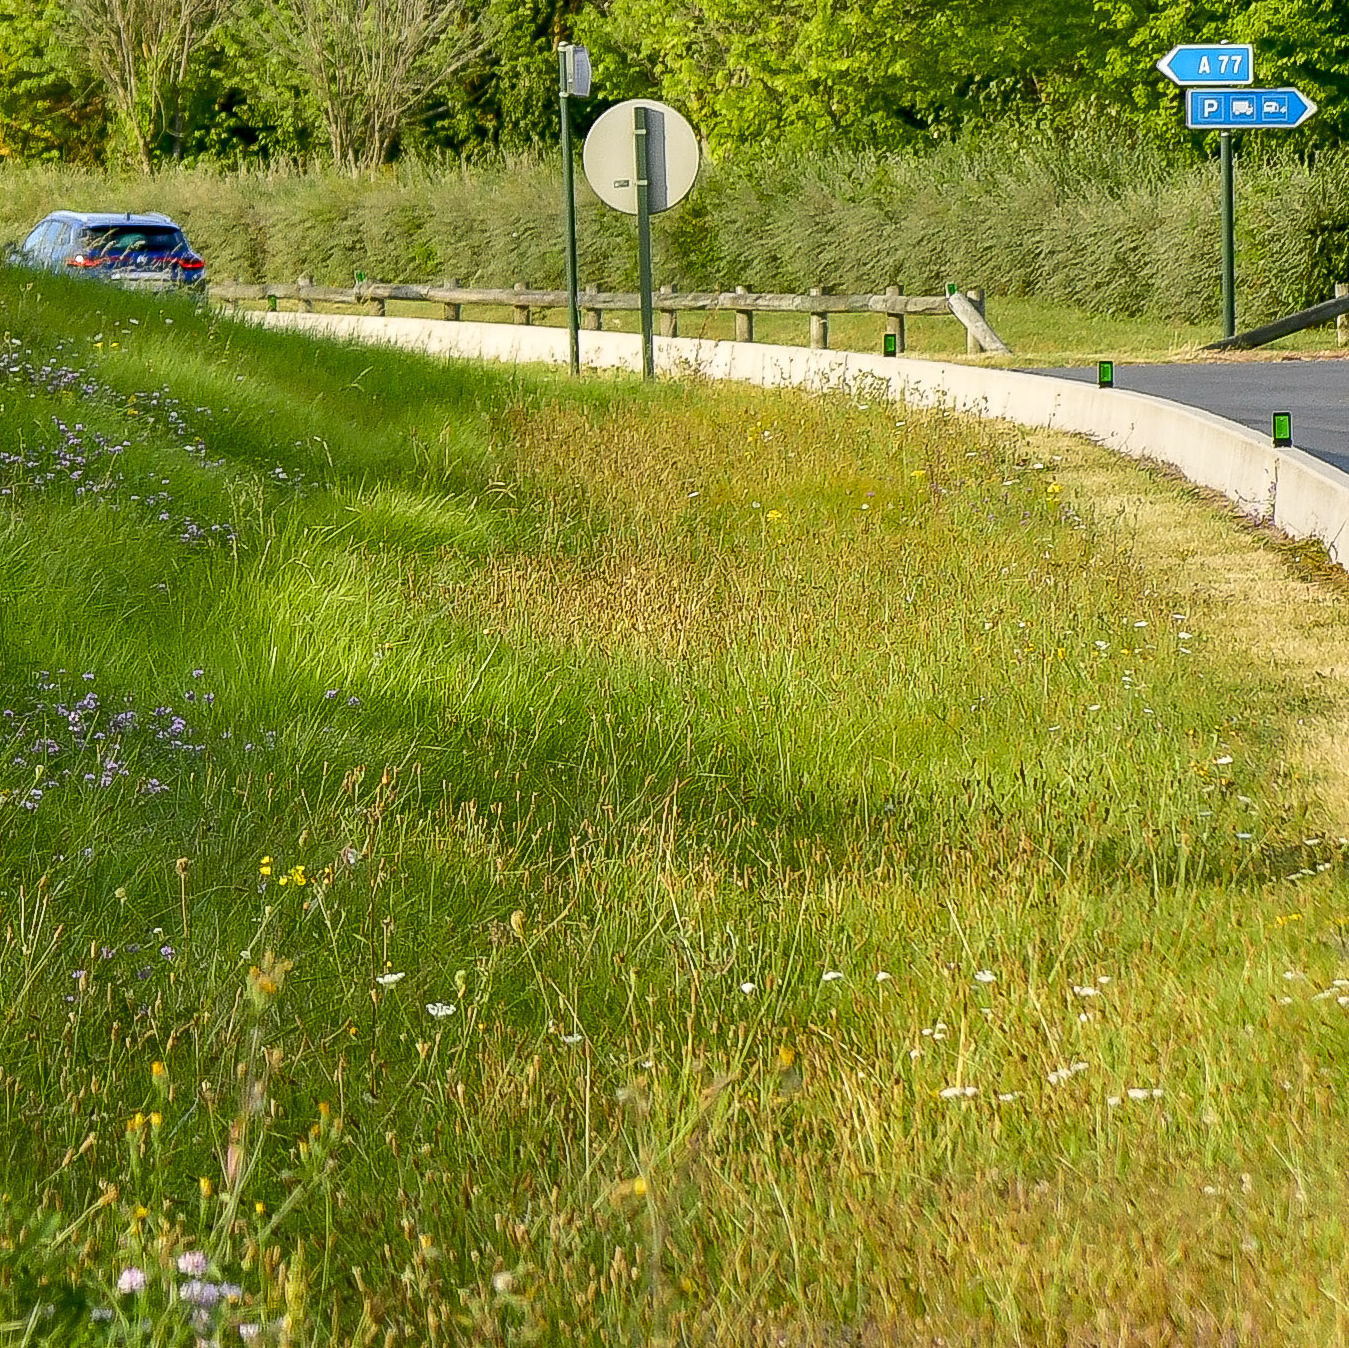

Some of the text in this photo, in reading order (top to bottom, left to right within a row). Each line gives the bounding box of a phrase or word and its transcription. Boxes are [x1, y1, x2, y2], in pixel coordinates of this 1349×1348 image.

[1198, 55, 1243, 74] A 77
[1203, 99, 1218, 118] P
